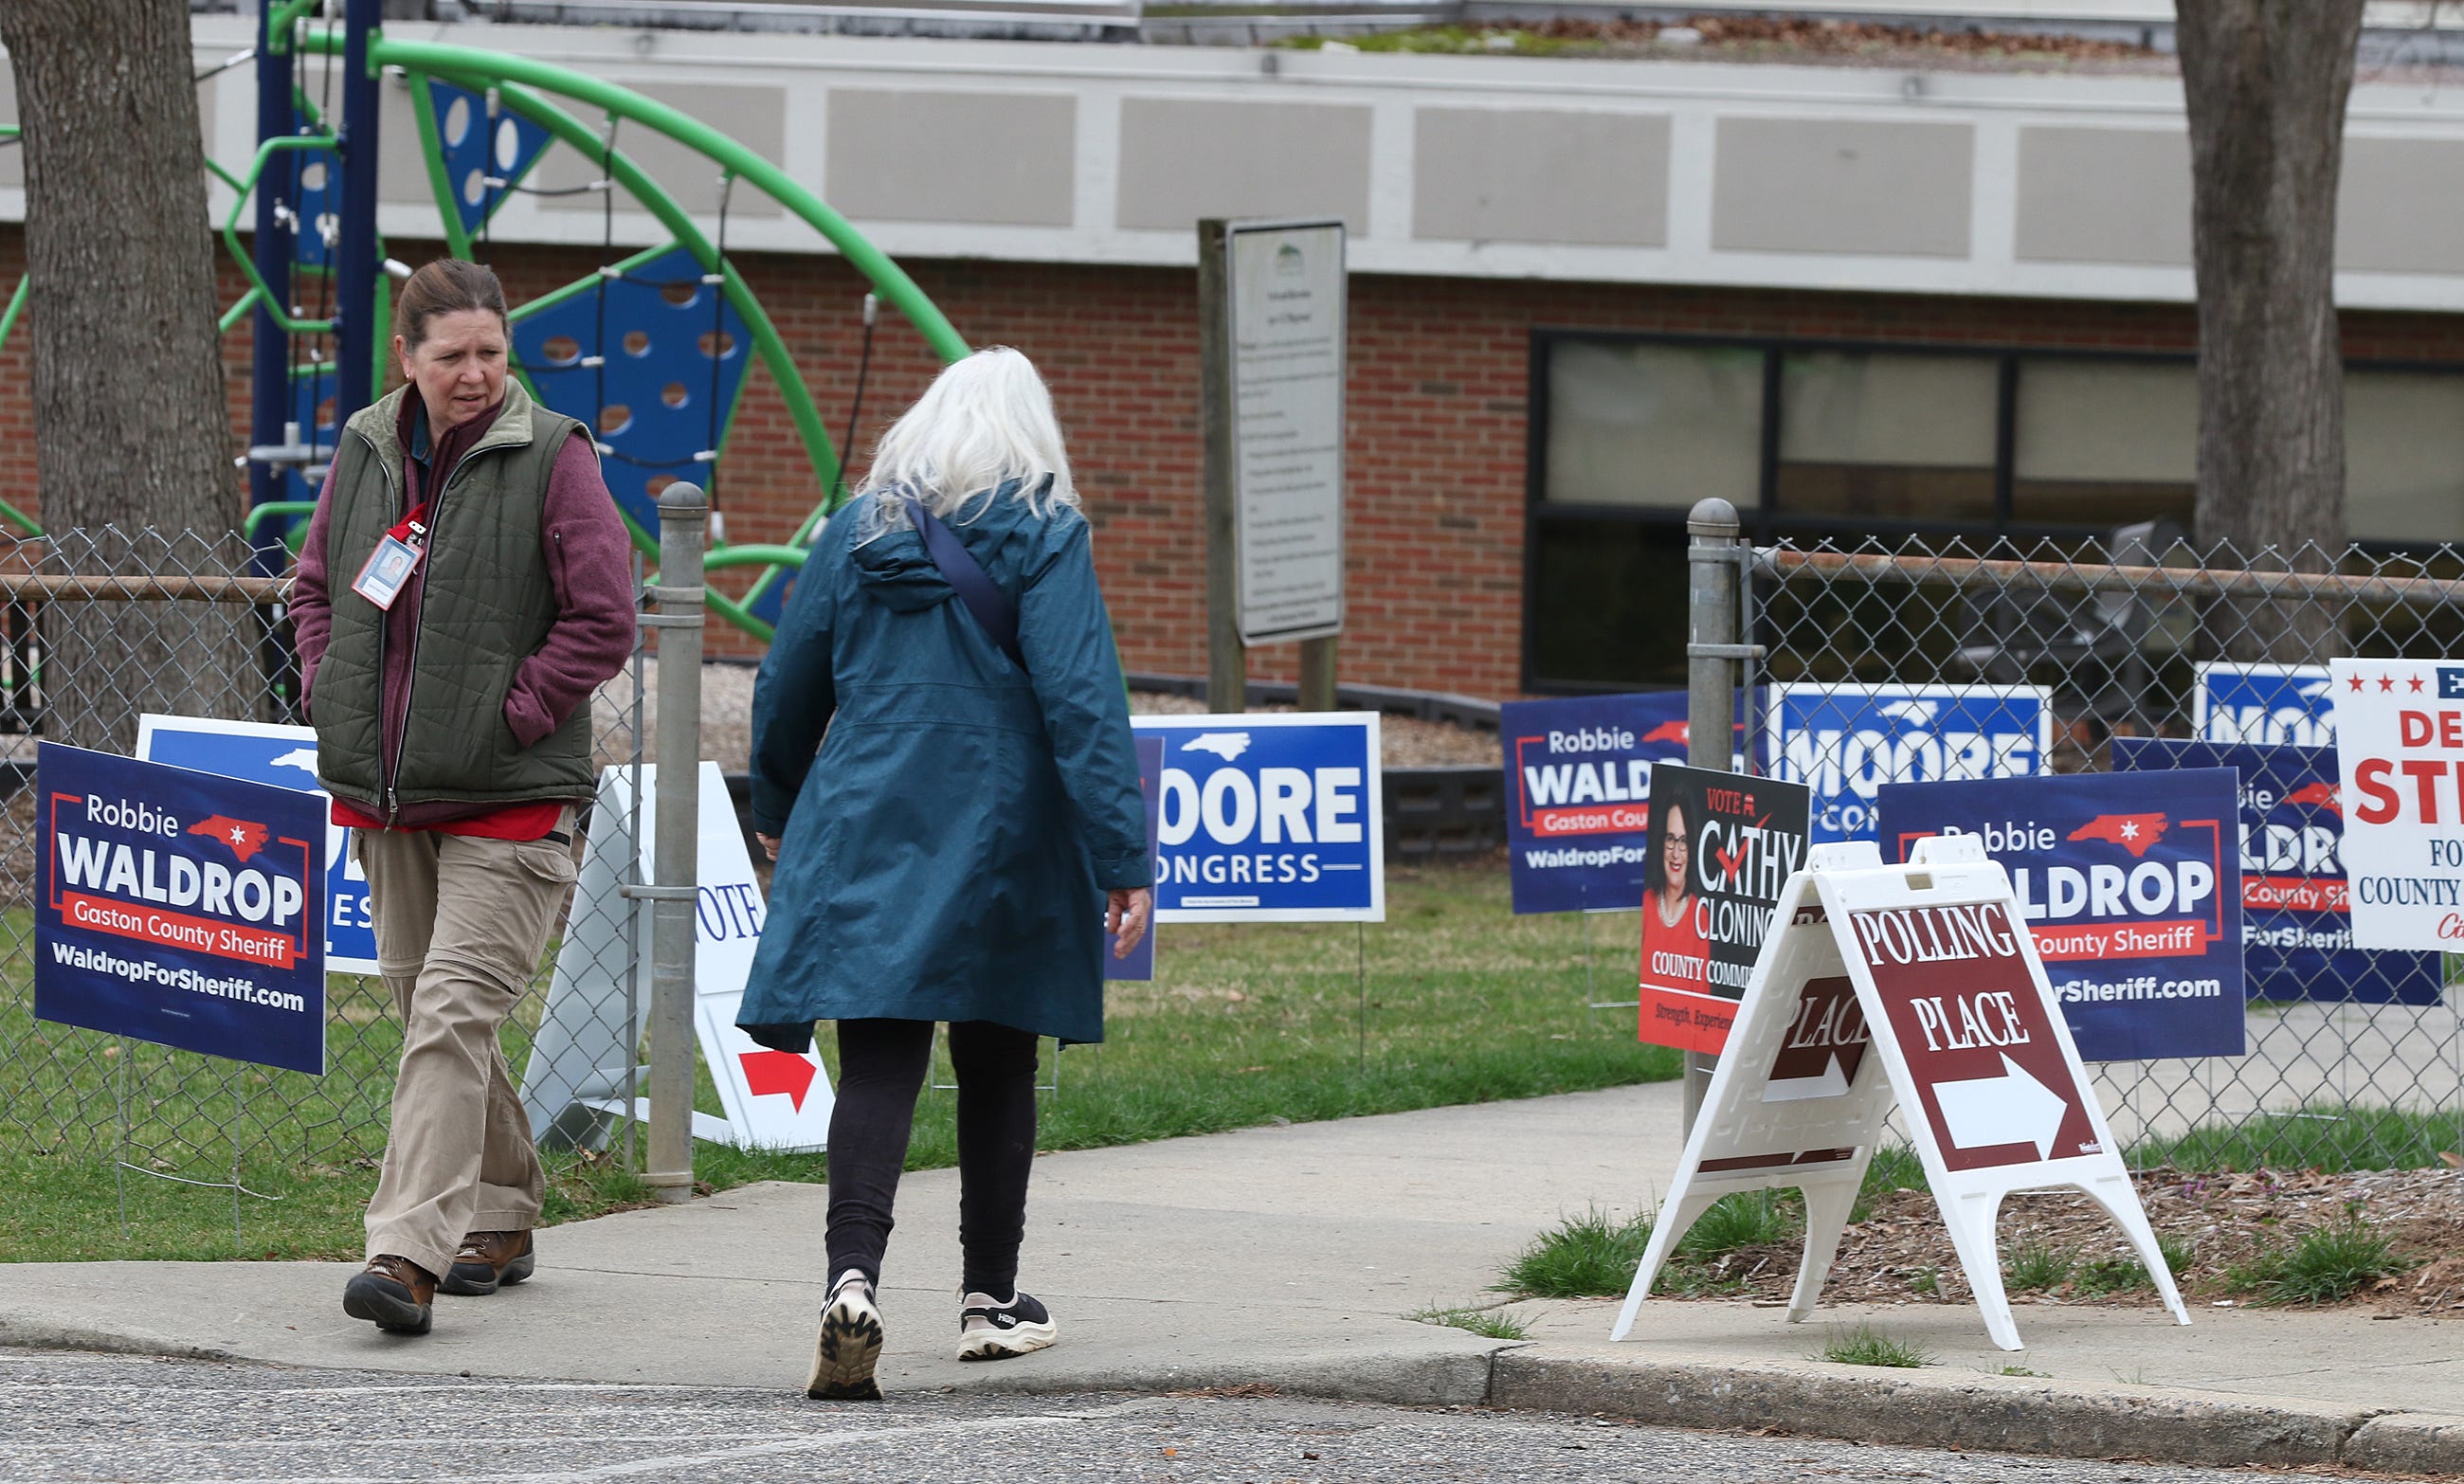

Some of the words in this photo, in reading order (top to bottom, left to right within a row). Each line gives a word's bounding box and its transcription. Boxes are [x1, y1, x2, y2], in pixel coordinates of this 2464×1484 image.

[1549, 727, 1635, 754] Robbie
[1785, 729, 2035, 799] MOORE
[1157, 767, 1363, 845] OORE
[1707, 787, 1741, 815] VOTE
[2355, 757, 2464, 825] ST
[86, 793, 179, 838] Robbie
[1543, 813, 1609, 832] Gaston
[1944, 822, 2056, 853] bbie
[1155, 854, 1320, 884] ONGRESS
[1526, 845, 1647, 869] WaldropFor
[1697, 820, 1802, 901] CATHY
[2429, 840, 2464, 868] FO
[57, 832, 304, 927] WALDROP
[2015, 860, 2215, 920] LDROP
[2244, 881, 2320, 910] County
[2360, 877, 2460, 906] COUNTY
[74, 901, 142, 933] Gaston
[148, 915, 216, 952] County
[220, 930, 286, 962] Sheriff
[697, 883, 762, 944] OTE
[1853, 903, 2017, 966] POLLING
[2114, 926, 2195, 952] Sheriff
[52, 941, 304, 1013] WaldropForSheriff.com
[1651, 950, 1705, 983] COUNTY
[1910, 991, 2031, 1052] PLACE
